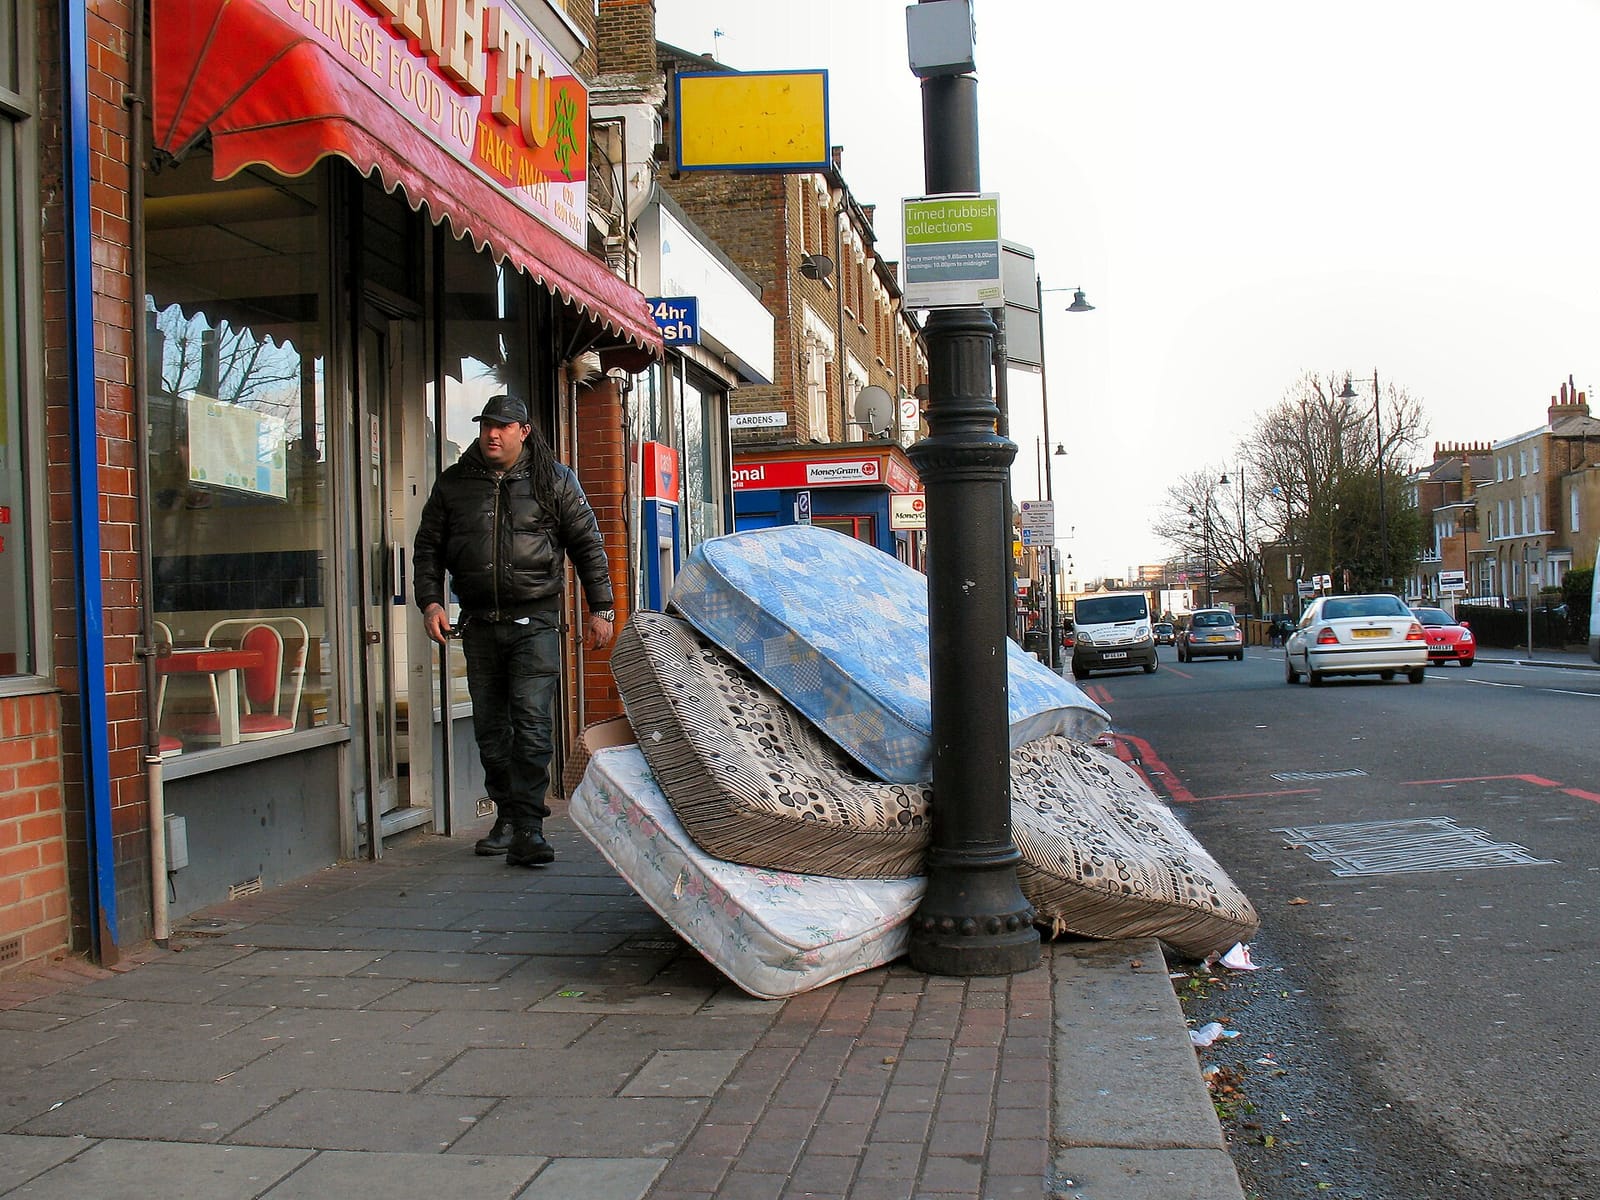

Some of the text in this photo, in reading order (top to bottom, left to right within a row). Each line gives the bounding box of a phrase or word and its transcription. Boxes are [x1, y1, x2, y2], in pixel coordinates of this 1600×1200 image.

[488, 7, 554, 148] TU
[388, 44, 443, 126] FOOD
[449, 95, 473, 148] TO
[478, 120, 513, 181] TAKE
[517, 155, 551, 211] AWAY
[906, 205, 996, 220] Timed rubbish
[906, 222, 973, 235] collections
[736, 416, 773, 425] GARDENS
[810, 467, 859, 477] MoneyGram
